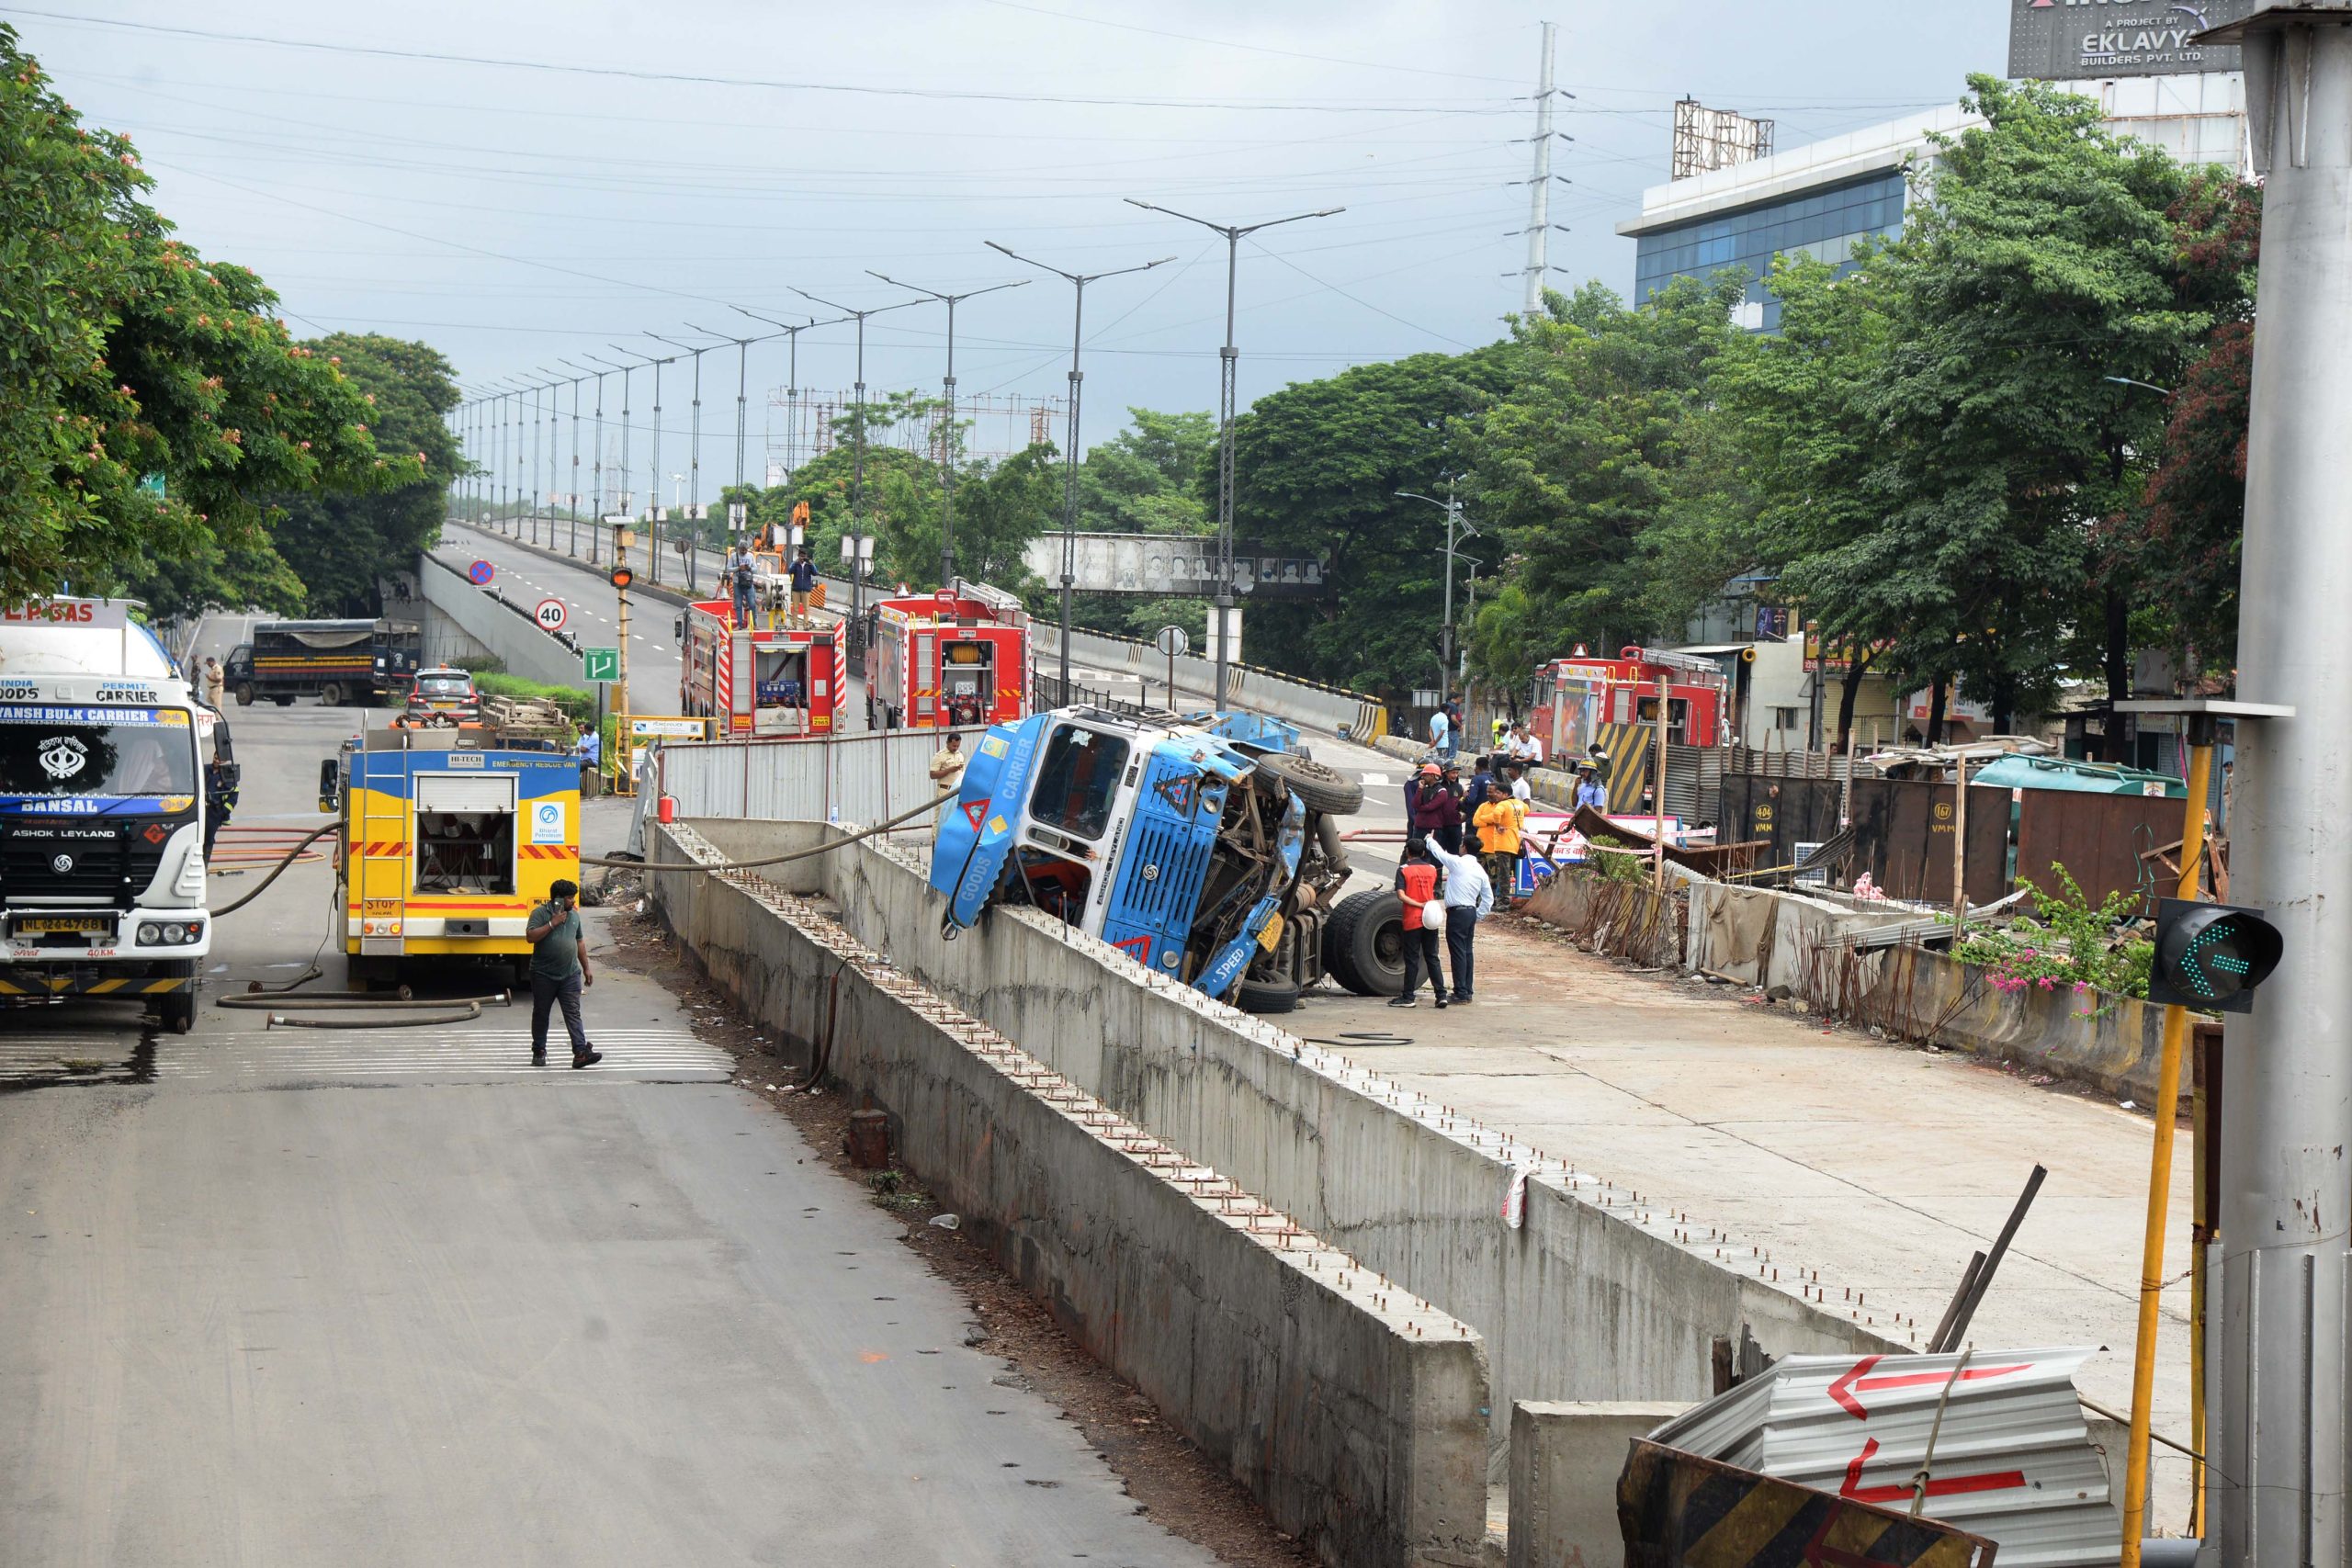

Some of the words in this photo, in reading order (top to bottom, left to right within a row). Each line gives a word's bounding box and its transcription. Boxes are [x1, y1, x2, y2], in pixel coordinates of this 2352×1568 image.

[2117, 17, 2161, 27] PROJECT
[2081, 55, 2141, 66] BUILDERS
[2146, 54, 2174, 62] PVT.
[2179, 52, 2204, 61] LTD.
[540, 608, 560, 622] 40
[96, 691, 158, 703] CARRIER
[45, 708, 83, 721] BULK
[87, 709, 149, 721] CARRIER
[1002, 738, 1033, 799] CARRIER
[22, 799, 97, 813] BANSAL
[1755, 823, 1772, 832] VMM
[1932, 824, 1956, 833] VMM
[1099, 869, 1112, 905] ASHOK
[1109, 818, 1125, 863] LEYLAND
[962, 856, 991, 900] GOODS
[367, 899, 395, 909] STOP
[1216, 948, 1244, 980] SPEED
